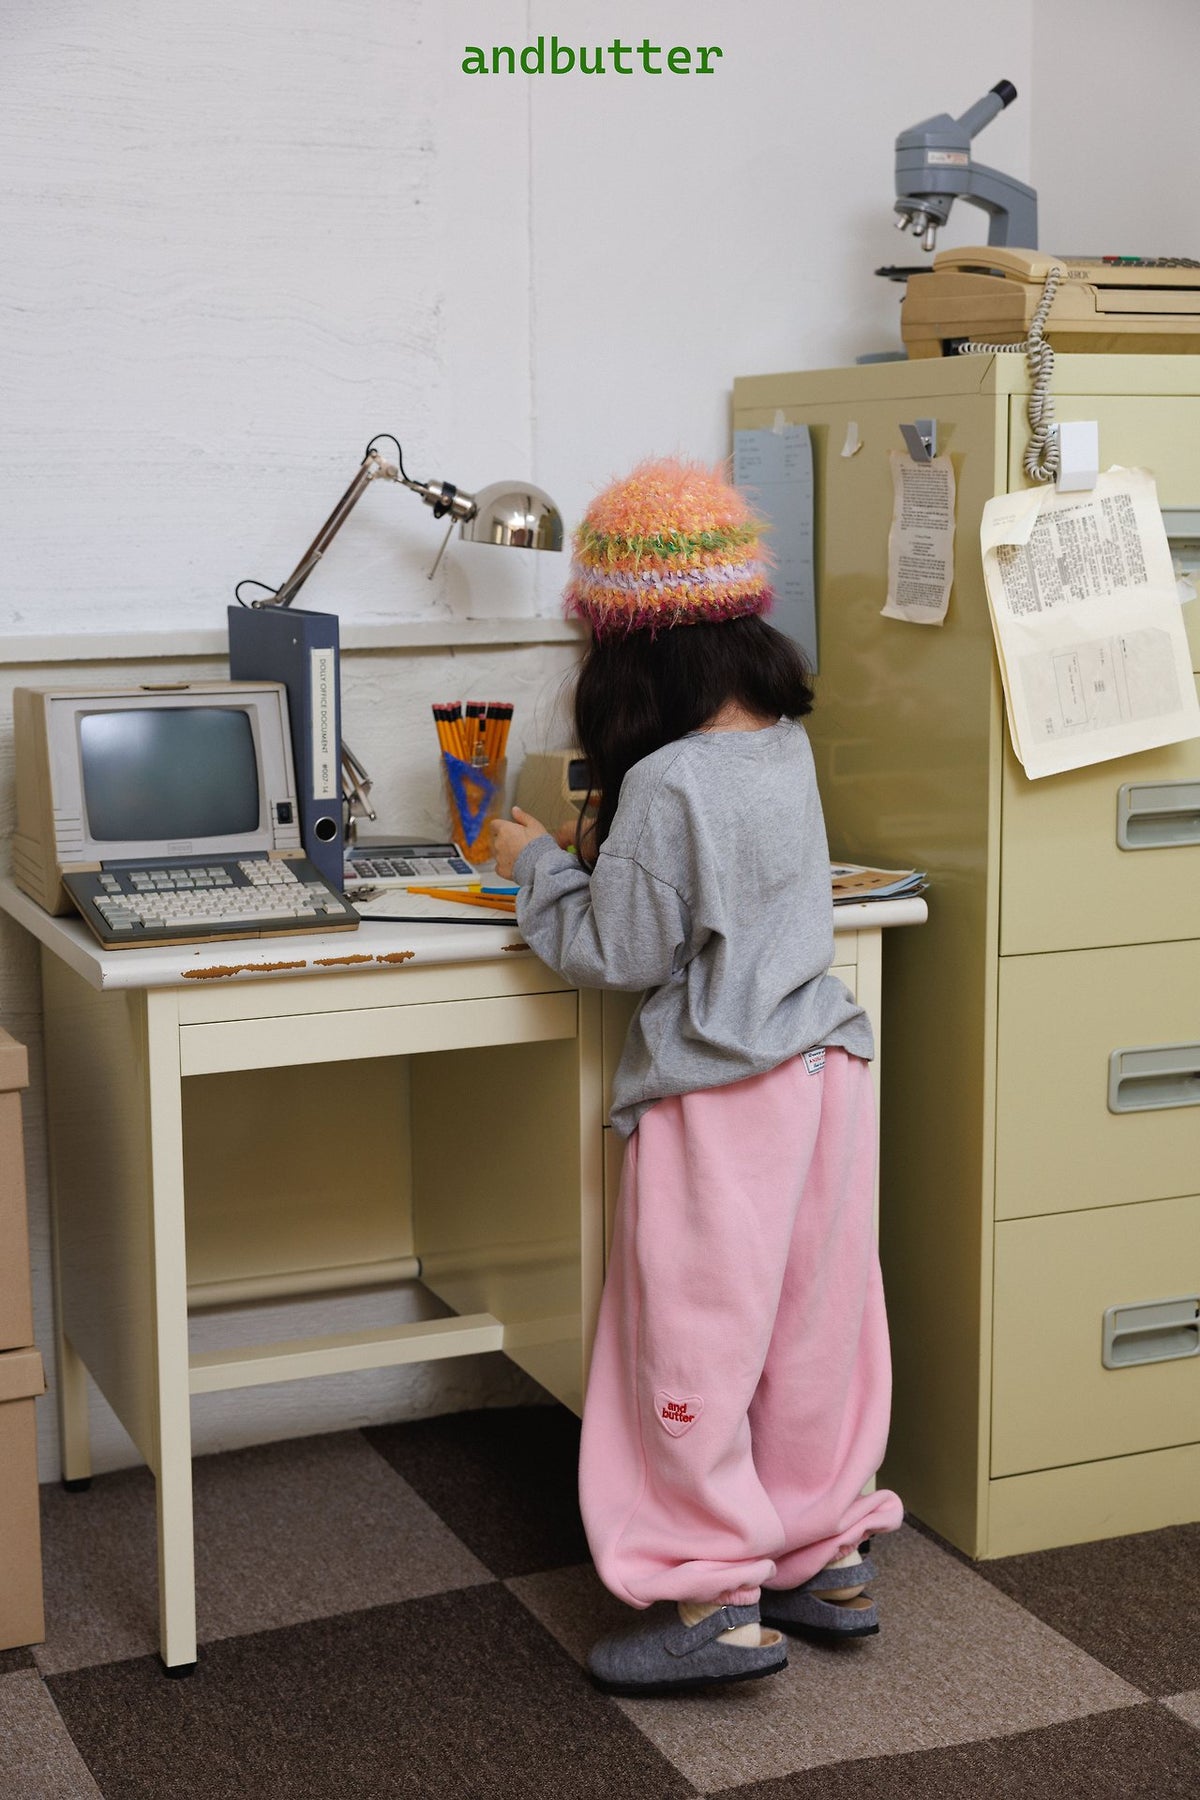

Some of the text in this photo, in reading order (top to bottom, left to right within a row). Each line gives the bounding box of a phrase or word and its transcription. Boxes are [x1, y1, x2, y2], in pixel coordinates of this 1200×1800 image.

[320, 683, 328, 708] OFFICE
[662, 1407, 695, 1423] butter
[668, 1402, 687, 1414] and
